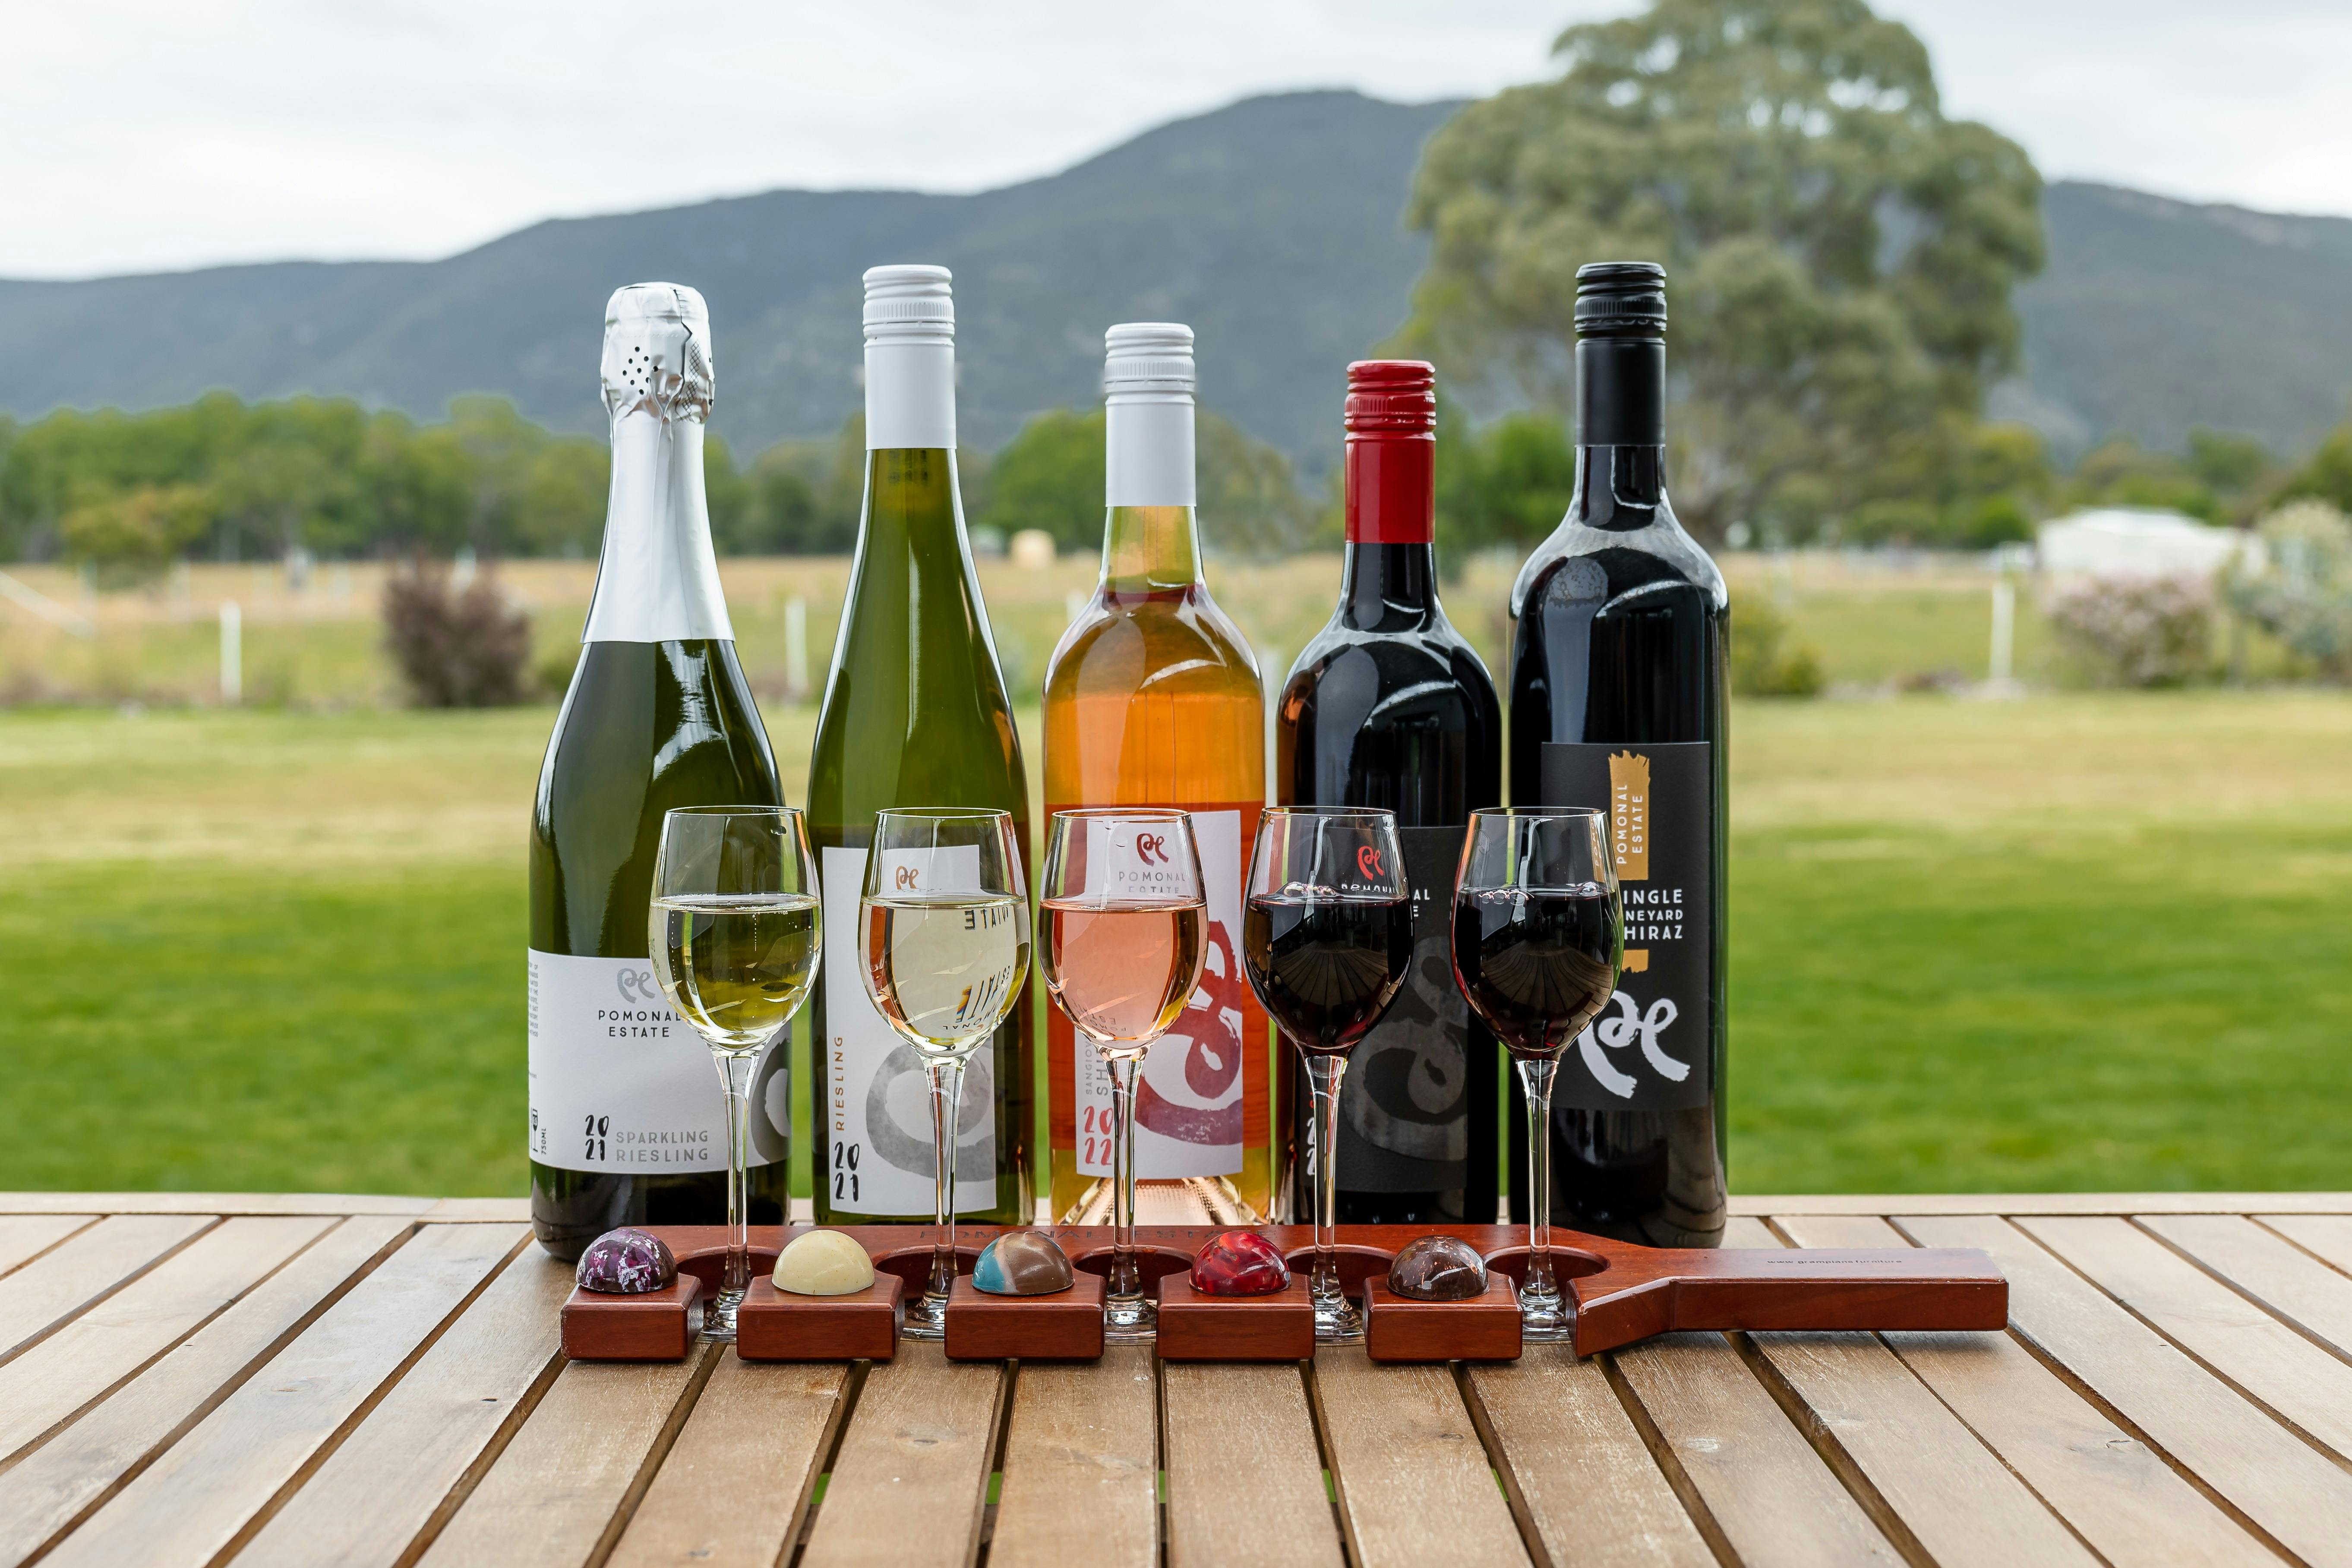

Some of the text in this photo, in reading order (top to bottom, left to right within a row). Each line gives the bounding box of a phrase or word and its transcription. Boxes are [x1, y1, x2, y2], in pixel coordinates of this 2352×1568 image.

[1616, 784, 1628, 864] POMONAL
[1632, 795, 1643, 854] ESTATE
[1119, 871, 1185, 882] POMONAL
[1623, 889, 1683, 905] INGLE
[1625, 909, 1683, 921] NEYARD
[1624, 924, 1683, 940] HIRAZ
[598, 1010, 682, 1022] POMONAL
[609, 1026, 669, 1038] ESTATE
[834, 1037, 845, 1131] RIESLING
[585, 1114, 609, 1138] 20
[1084, 1105, 1114, 1136] 20
[616, 1130, 708, 1144] SPARKLING
[585, 1138, 605, 1161] 21
[616, 1148, 708, 1162] RIESLING
[834, 1141, 860, 1171] 20
[1085, 1136, 1112, 1166] 22
[835, 1172, 859, 1202] 21
[920, 1230, 1103, 1239] POMNAL
